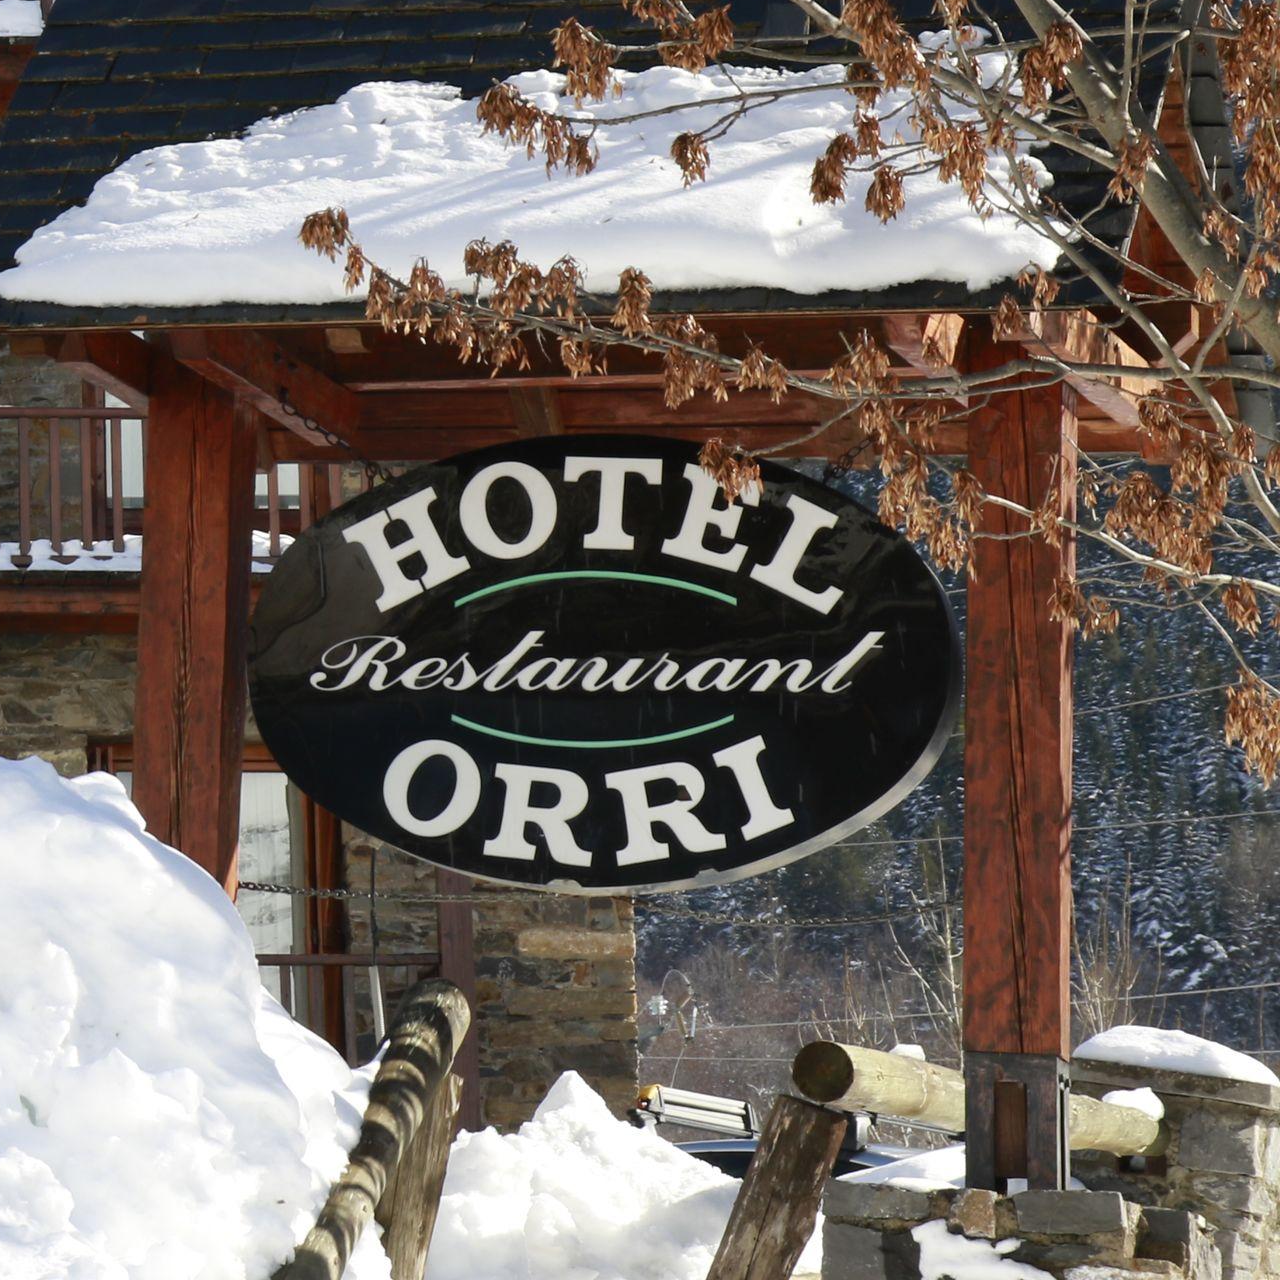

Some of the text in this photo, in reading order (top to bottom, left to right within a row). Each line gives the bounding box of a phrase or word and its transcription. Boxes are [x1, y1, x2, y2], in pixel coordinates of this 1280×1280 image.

[342, 457, 844, 614] HOTEL
[310, 630, 885, 694] Restaurant
[383, 735, 795, 867] ORRI
